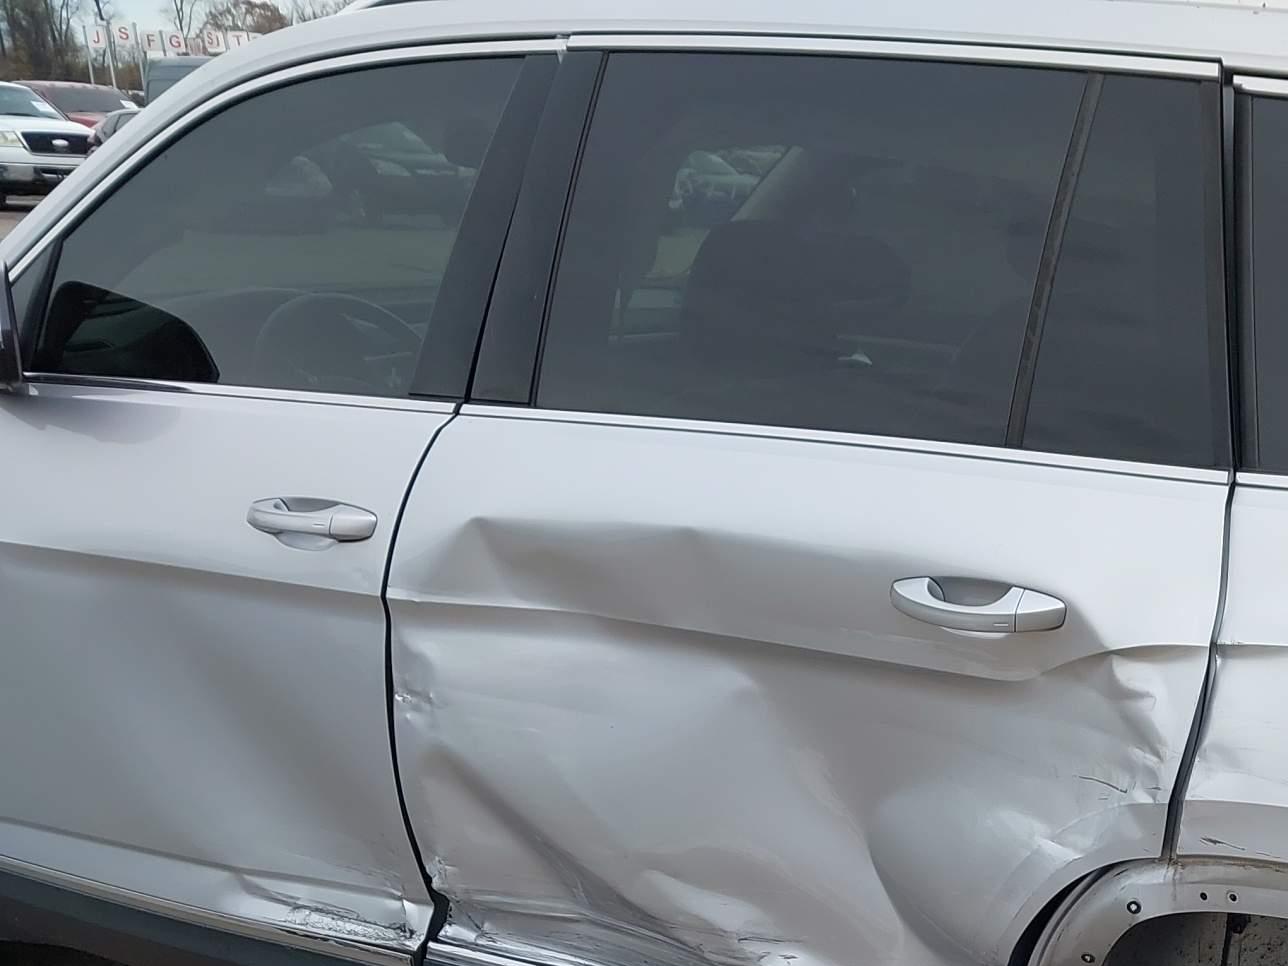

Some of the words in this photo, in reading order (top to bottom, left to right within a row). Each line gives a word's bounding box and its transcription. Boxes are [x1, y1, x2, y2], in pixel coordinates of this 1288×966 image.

[93, 30, 100, 44] J
[118, 26, 129, 41] S
[146, 33, 155, 48] F
[169, 34, 181, 49] G
